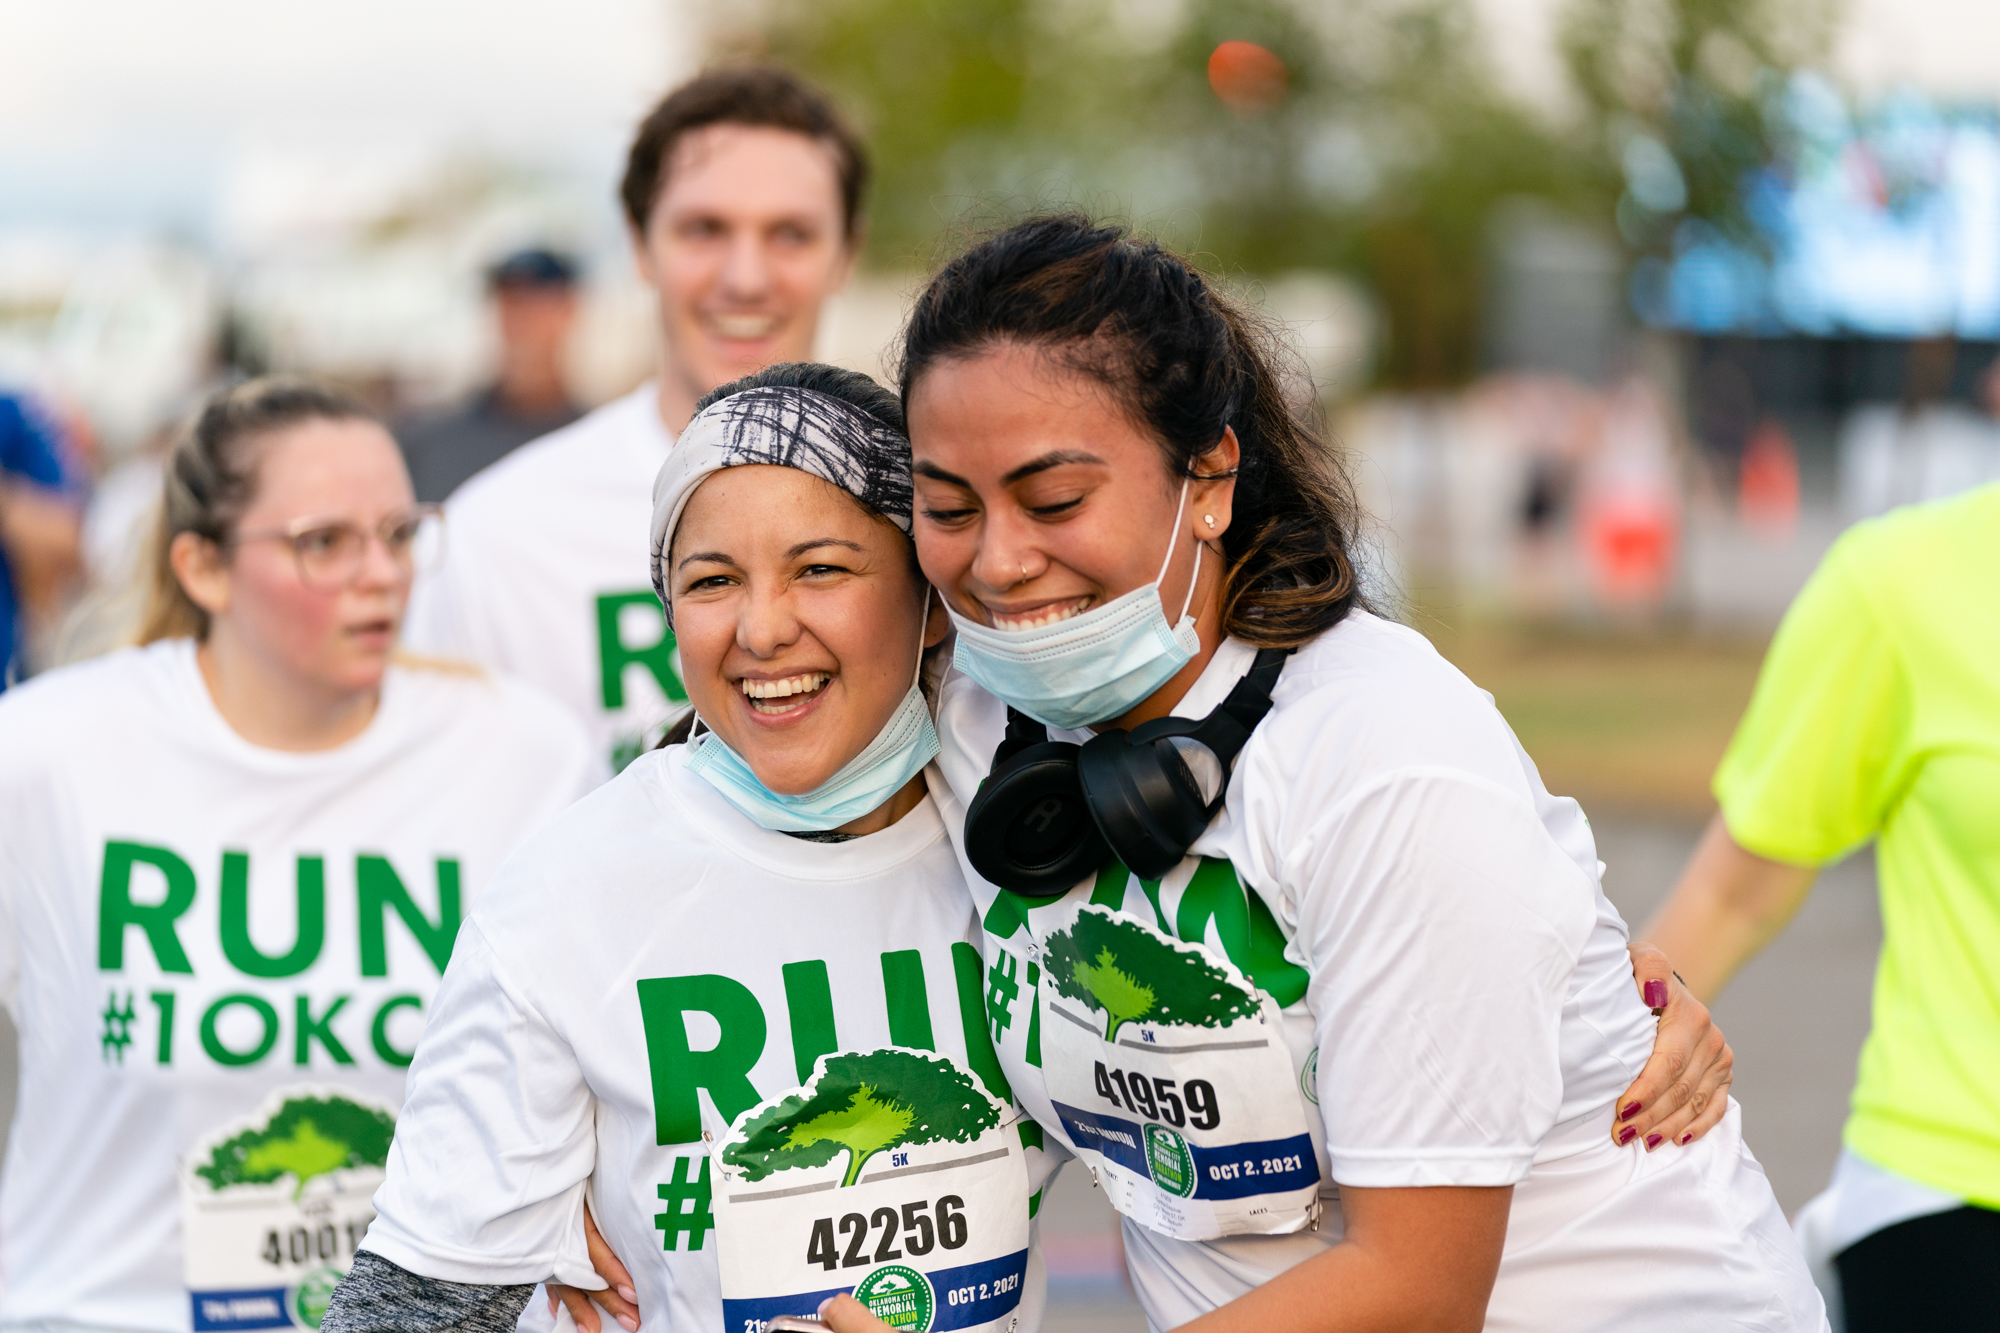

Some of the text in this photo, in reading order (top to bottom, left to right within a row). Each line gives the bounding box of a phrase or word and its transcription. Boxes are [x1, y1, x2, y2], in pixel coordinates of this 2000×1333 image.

[98, 838, 463, 979] RUN
[1141, 1029, 1156, 1043] 5K
[1094, 1060, 1220, 1130] 41959
[892, 1152, 909, 1168] 5K
[1209, 1154, 1302, 1181] OCT 2, 2021
[262, 1217, 376, 1266] 4001
[807, 1194, 969, 1271] 42256
[868, 1292, 915, 1307] OKLAHOMA CITY
[948, 1273, 1019, 1306] OCT 2, 2021
[869, 1300, 917, 1318] MEMORIAL
